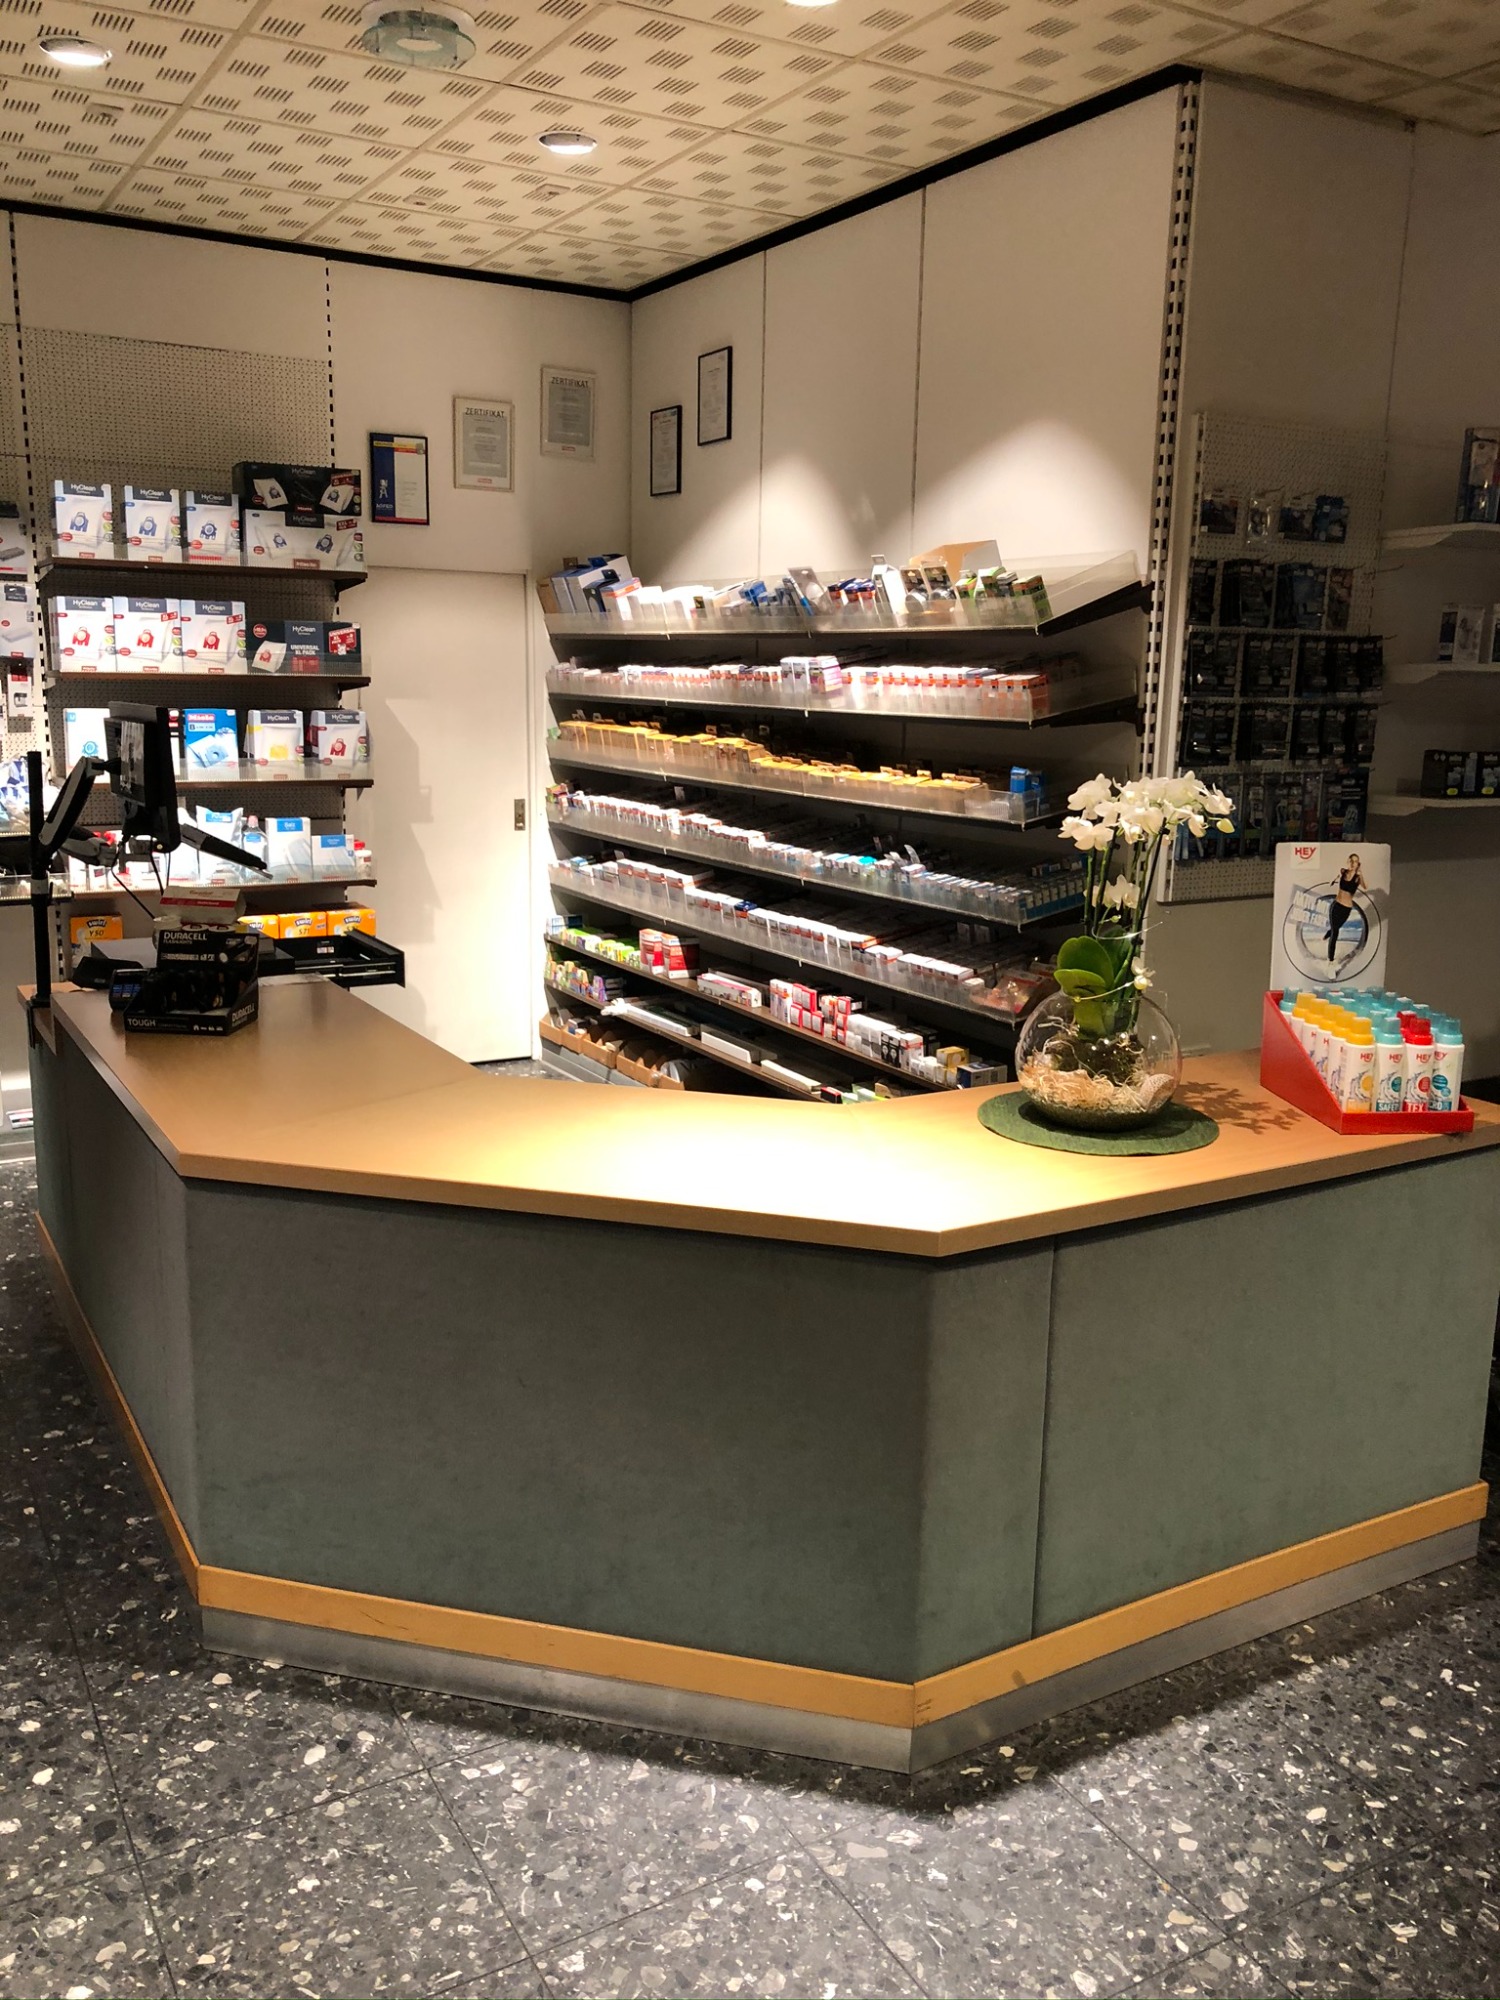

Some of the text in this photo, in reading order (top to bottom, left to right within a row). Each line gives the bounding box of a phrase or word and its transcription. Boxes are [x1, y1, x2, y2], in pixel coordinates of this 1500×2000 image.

[551, 376, 589, 389] ZERTIFIKAT
[465, 407, 505, 418] ZERTIFIKAT
[140, 489, 165, 498] HyClean
[73, 599, 98, 607] HyClean
[1294, 847, 1317, 859] HEY
[163, 931, 207, 940] DURACELL
[231, 1003, 255, 1022] DURACELL
[128, 1018, 156, 1027] TOUGH
[1416, 1054, 1431, 1063] HEY
